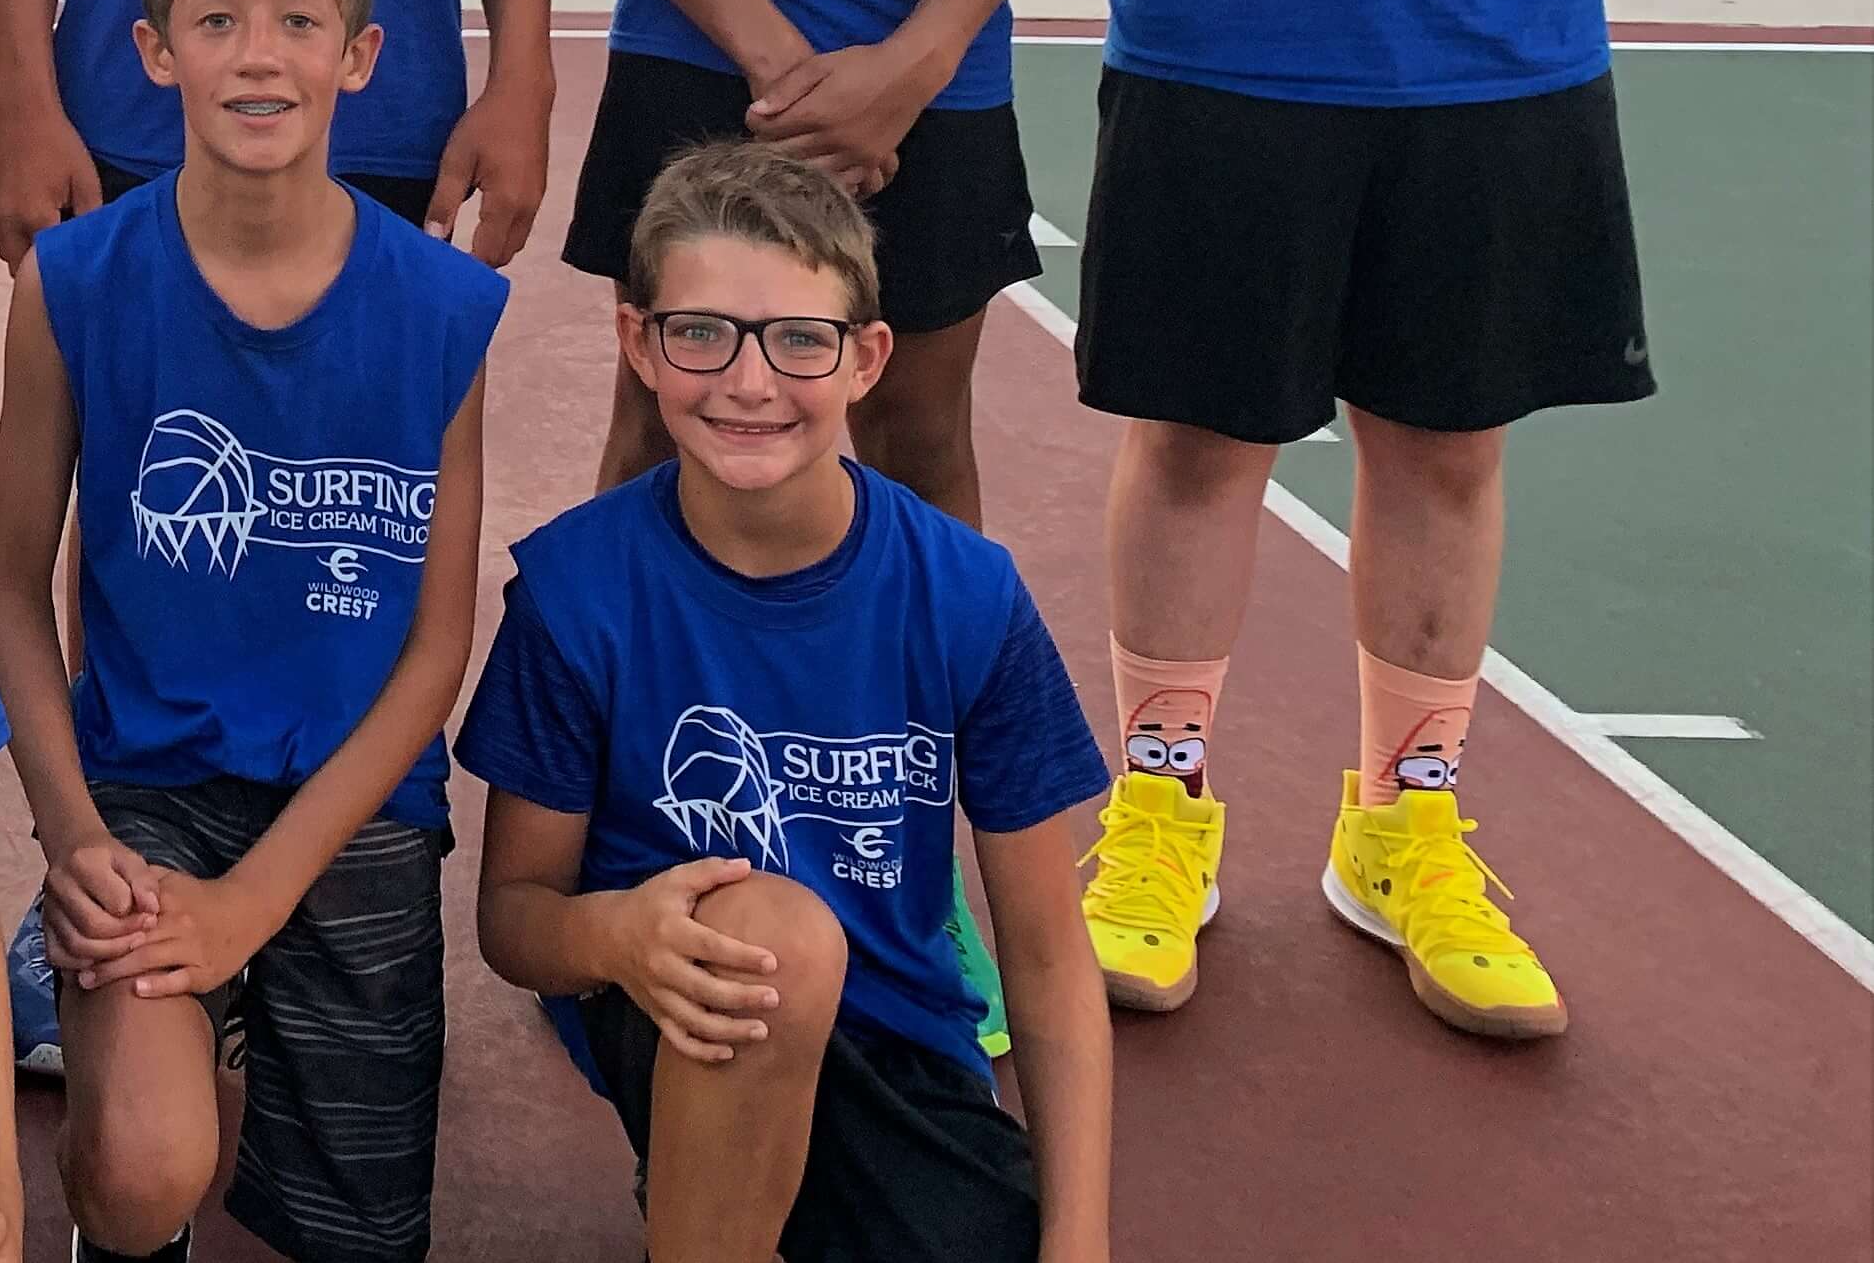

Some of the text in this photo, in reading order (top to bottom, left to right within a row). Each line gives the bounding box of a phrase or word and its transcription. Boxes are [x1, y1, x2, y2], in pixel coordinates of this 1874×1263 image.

[268, 468, 437, 520] SURFING
[270, 508, 429, 545] ICE CREAM TRUC
[306, 593, 378, 621] CREST
[307, 582, 380, 603] WILDWOOD
[783, 734, 938, 787] SURFIG
[789, 783, 824, 804] ICE
[827, 788, 901, 810] CREAM
